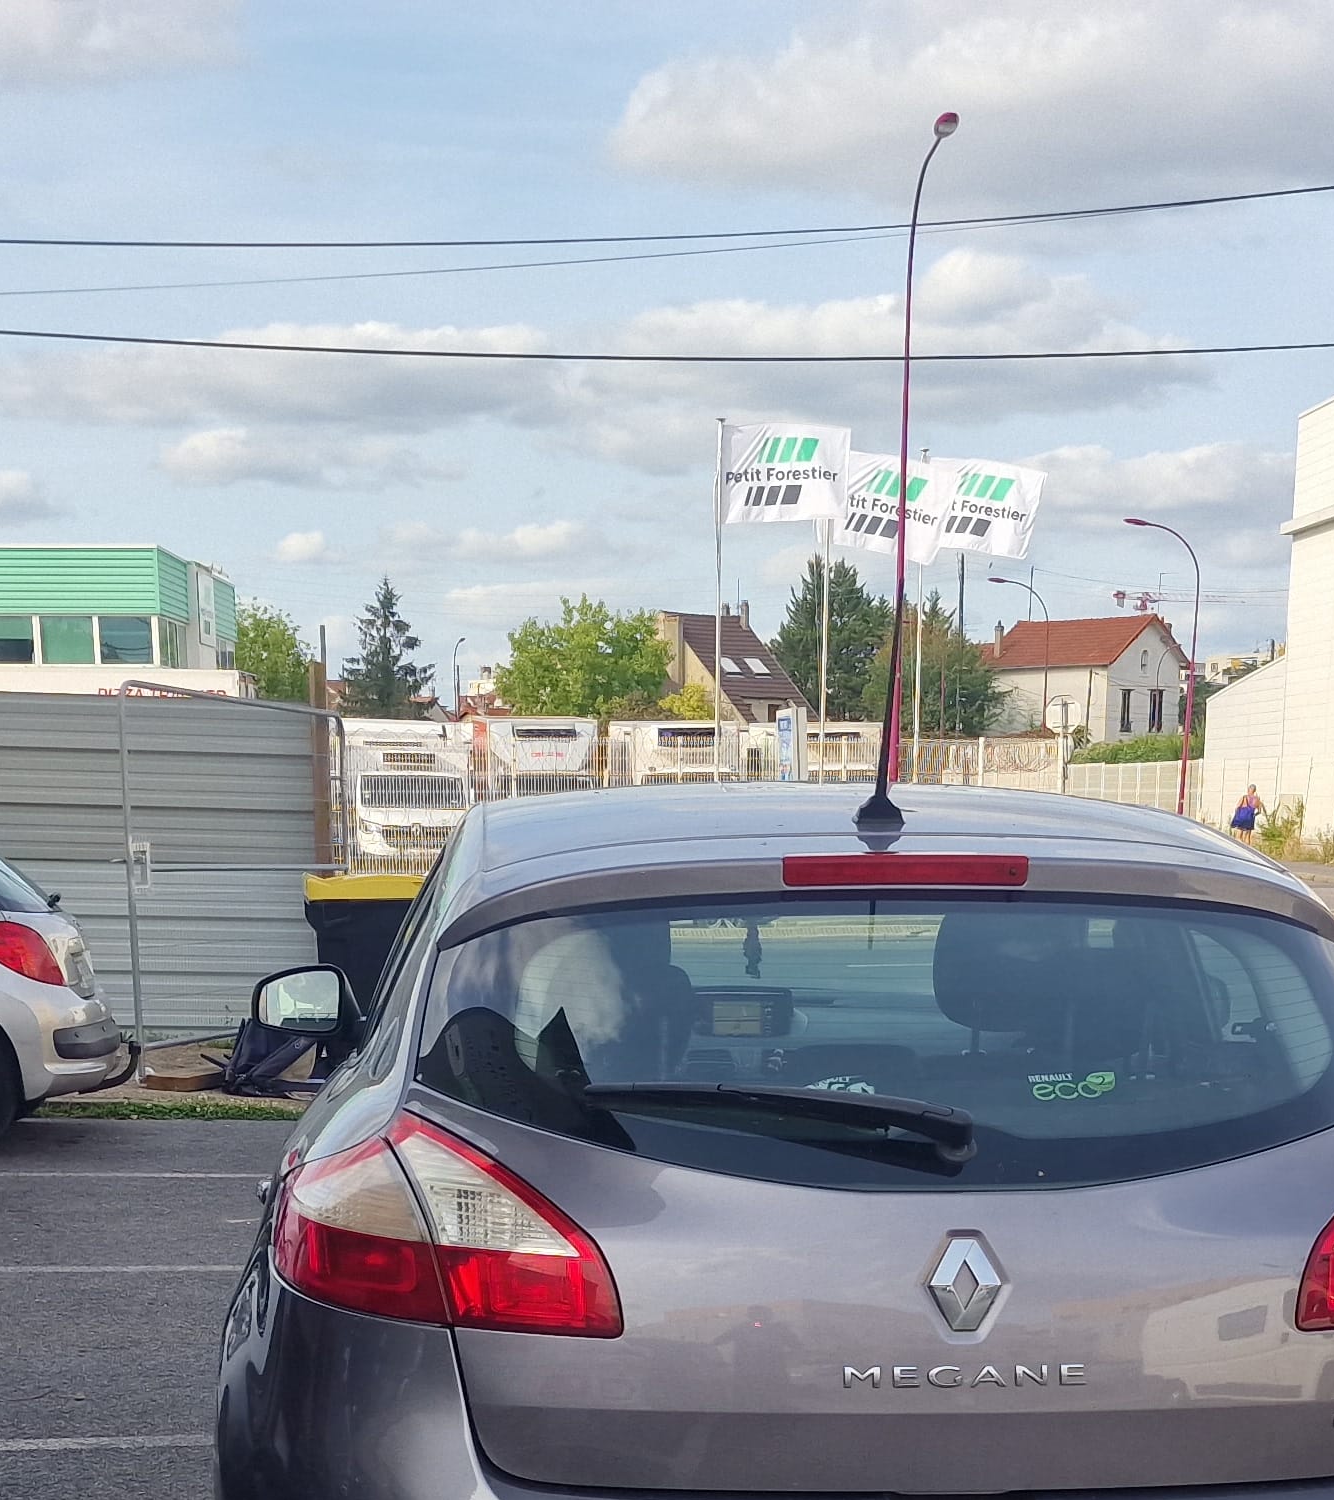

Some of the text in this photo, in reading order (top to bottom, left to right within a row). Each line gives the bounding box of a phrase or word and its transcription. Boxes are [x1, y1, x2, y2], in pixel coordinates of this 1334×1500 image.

[725, 466, 838, 485] Petit Forestier
[849, 494, 867, 510] tit
[961, 500, 1027, 523] Forestier
[1027, 1073, 1073, 1083] RENAULT
[842, 1363, 1088, 1389] MEGANE
